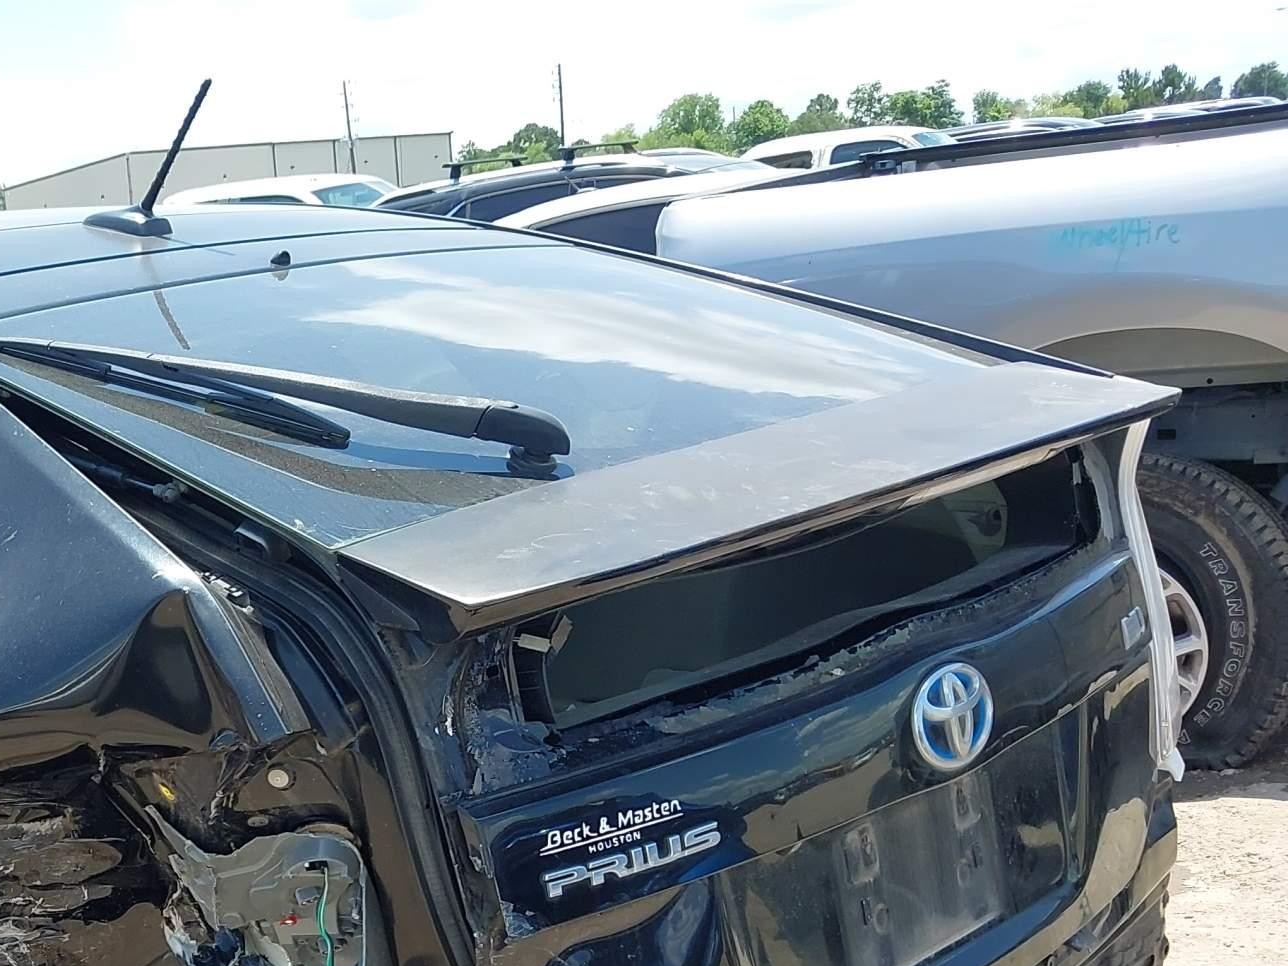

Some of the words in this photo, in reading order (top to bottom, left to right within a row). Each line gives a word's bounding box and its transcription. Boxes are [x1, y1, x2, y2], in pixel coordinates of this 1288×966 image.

[1193, 542, 1246, 727] TRANSFORCE
[541, 822, 597, 850] Beck
[599, 816, 616, 834] &
[618, 800, 682, 828] Masten
[588, 831, 641, 854] HOUSTON
[543, 821, 722, 898] PRIUS
